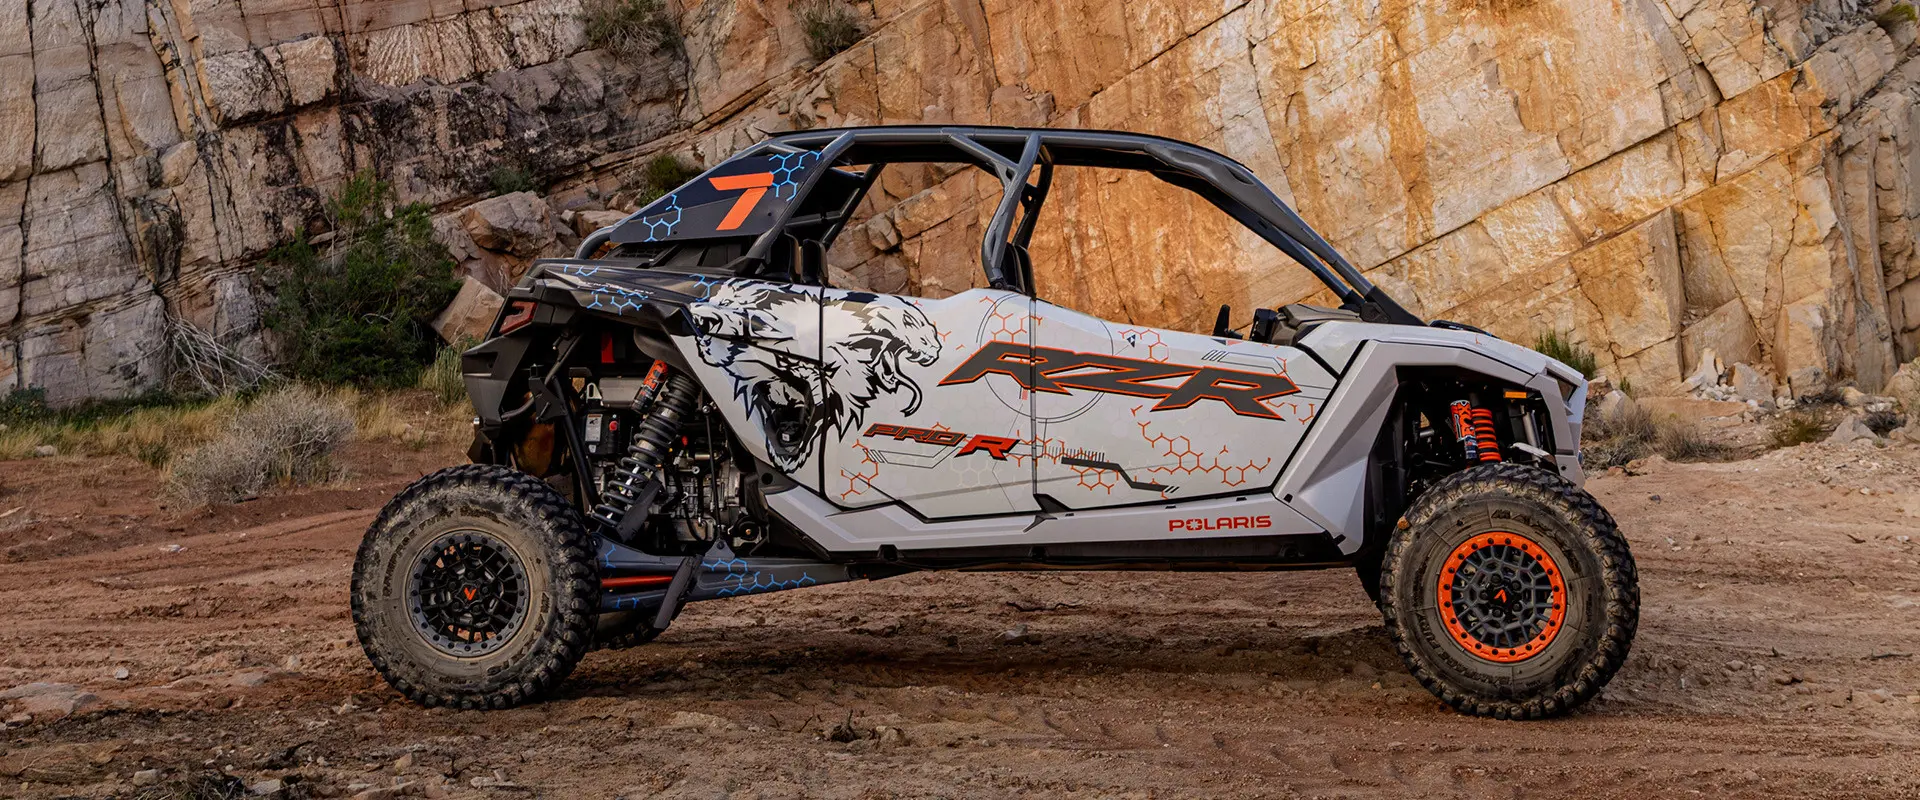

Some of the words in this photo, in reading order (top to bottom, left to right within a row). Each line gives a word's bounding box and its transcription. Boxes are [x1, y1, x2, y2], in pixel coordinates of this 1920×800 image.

[937, 340, 1303, 422] RZR
[863, 422, 967, 447] PRO
[953, 434, 1020, 462] R
[1168, 515, 1272, 532] POLARIS
